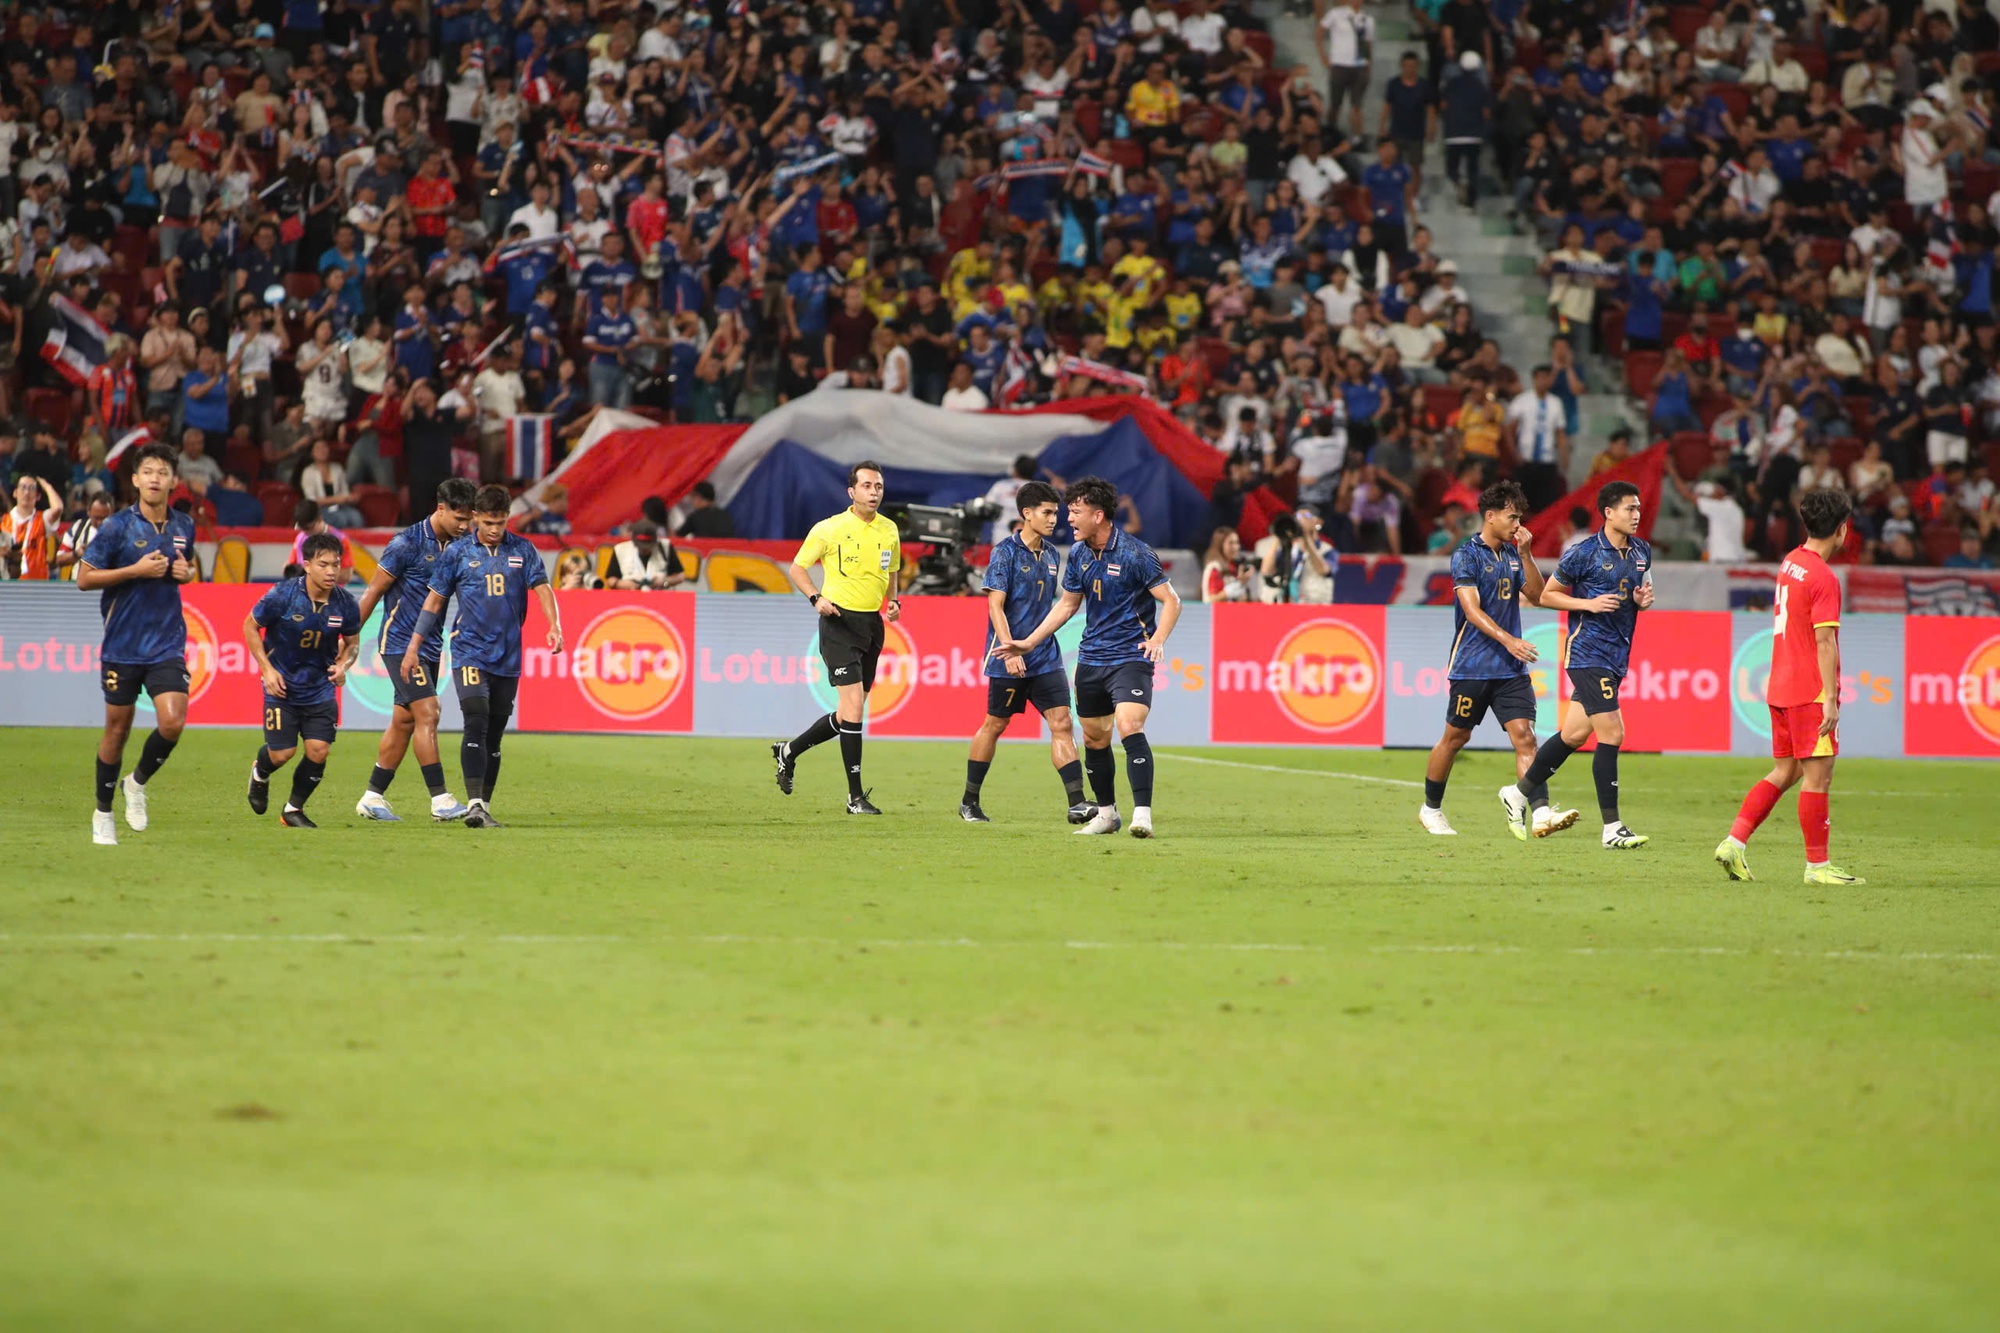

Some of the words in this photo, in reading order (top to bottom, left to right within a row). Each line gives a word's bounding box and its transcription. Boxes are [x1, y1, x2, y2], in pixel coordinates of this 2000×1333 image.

[485, 573, 505, 597] 18
[1037, 580, 1045, 601] 7
[1092, 579, 1103, 601] 4
[1497, 577, 1511, 600] 12
[1618, 578, 1629, 601] 5
[300, 629, 322, 649] 21
[524, 640, 680, 682] makro
[1217, 655, 1374, 694] makro
[1005, 688, 1016, 707] 7
[1600, 677, 1614, 700] 5
[1455, 694, 1473, 718] 12
[265, 707, 281, 730] 21
